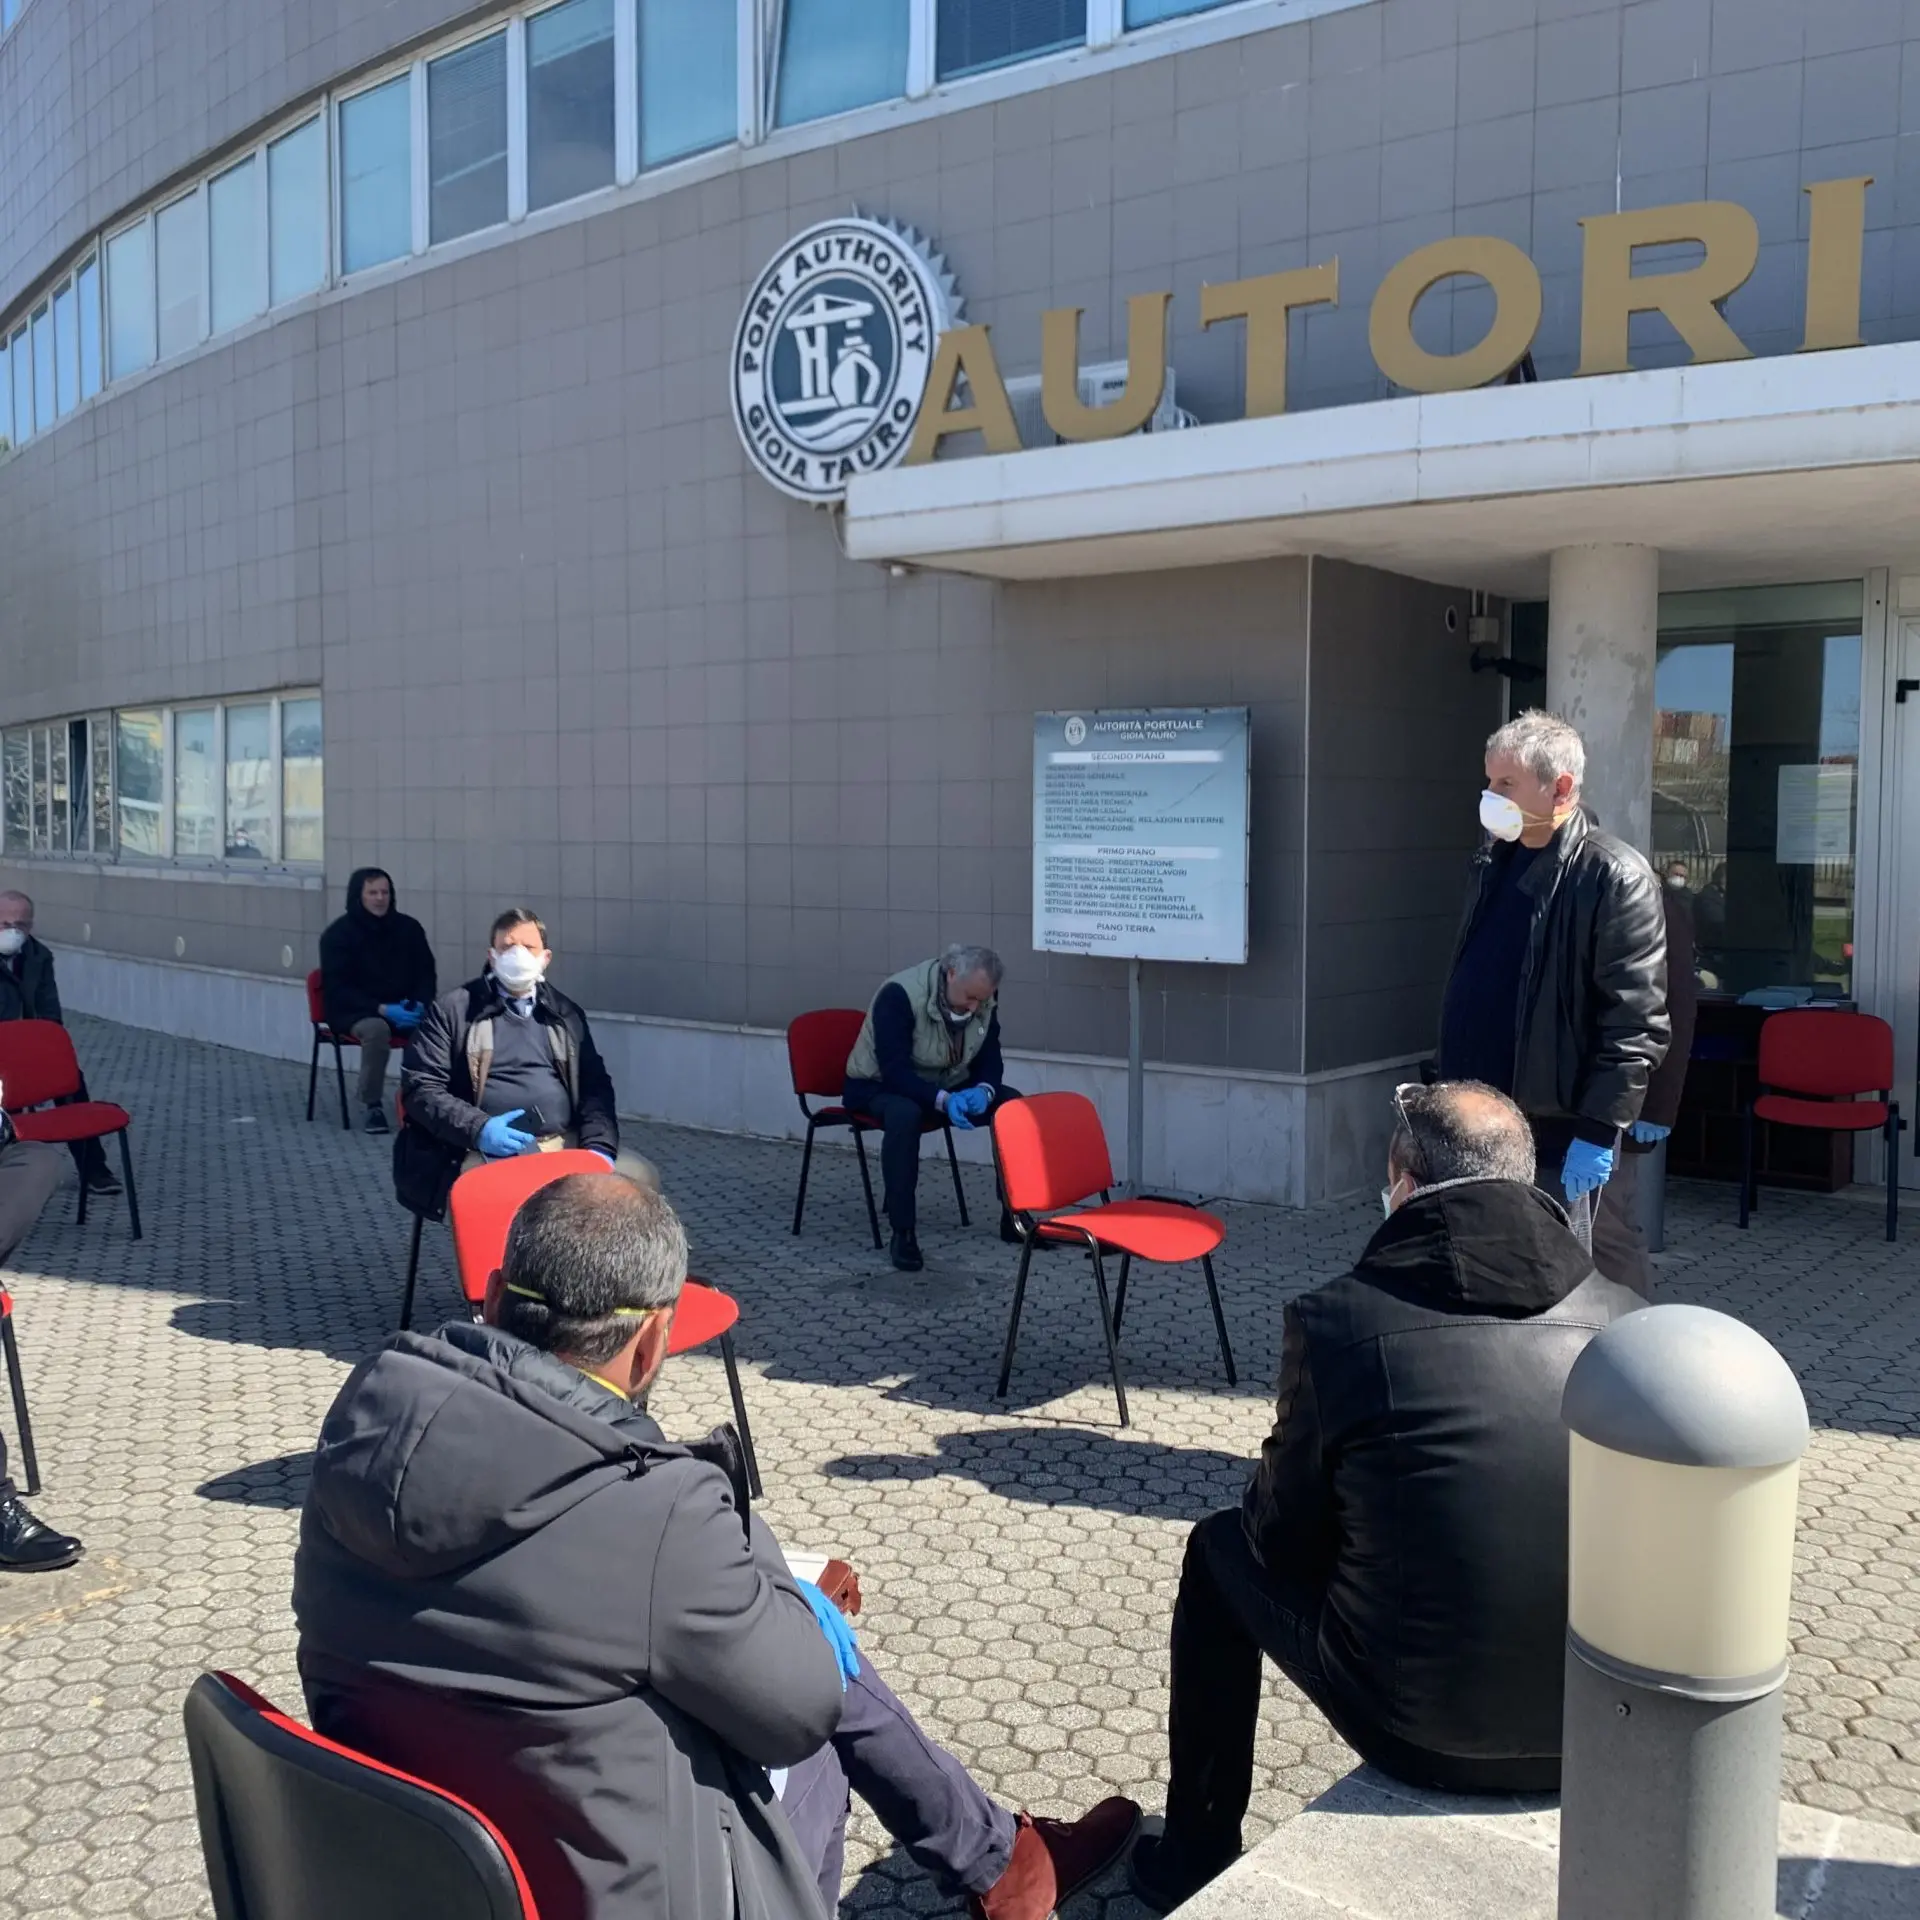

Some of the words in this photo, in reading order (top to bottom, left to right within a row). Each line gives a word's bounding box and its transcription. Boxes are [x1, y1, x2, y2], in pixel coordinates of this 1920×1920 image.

[743, 275, 785, 374] PORT
[794, 237, 925, 355] AUTHORITY
[904, 175, 1875, 466] AUTORI
[748, 403, 807, 484] GIOIA
[820, 397, 911, 484] TAURO
[1093, 719, 1141, 731] AUTORITÀ
[1144, 719, 1204, 730] PORTUALE
[1120, 732, 1145, 740] GIOIA
[1146, 731, 1177, 740] TAURO
[1091, 753, 1133, 761] SECONDO
[1135, 752, 1165, 760] PIANO
[1138, 816, 1183, 824] RELAZIONI
[1184, 816, 1225, 825] ESTERNE
[1097, 847, 1125, 856] PRIMO
[1127, 848, 1156, 856] PIANO
[1074, 857, 1104, 866] TECNICO
[1108, 859, 1175, 868] PROGETTAZIONE
[1045, 865, 1073, 873] SETTORE
[1074, 866, 1104, 874] TECNICO
[1108, 867, 1156, 876] ESECUZIONI
[1157, 868, 1187, 877] LAVORI
[1119, 876, 1164, 885] SICUREZZA
[1100, 884, 1165, 893] AMMINISTRATIVA
[1045, 890, 1073, 898] SETTORE
[1110, 893, 1131, 901] GARE
[1139, 894, 1186, 903] CONTRATTI
[1045, 898, 1073, 906] SETTORE
[1074, 900, 1098, 908] AFFARI
[1099, 901, 1137, 910] GENERALI
[1145, 903, 1196, 912] PERSONALE
[1074, 908, 1140, 918] AMMINISTRAZIONE
[1096, 923, 1123, 931] PIANO
[1125, 924, 1156, 933] TERRA
[1044, 930, 1069, 938] UFFICIO
[1070, 931, 1117, 941] PROTOCOLLO
[1045, 938, 1061, 946] SALA
